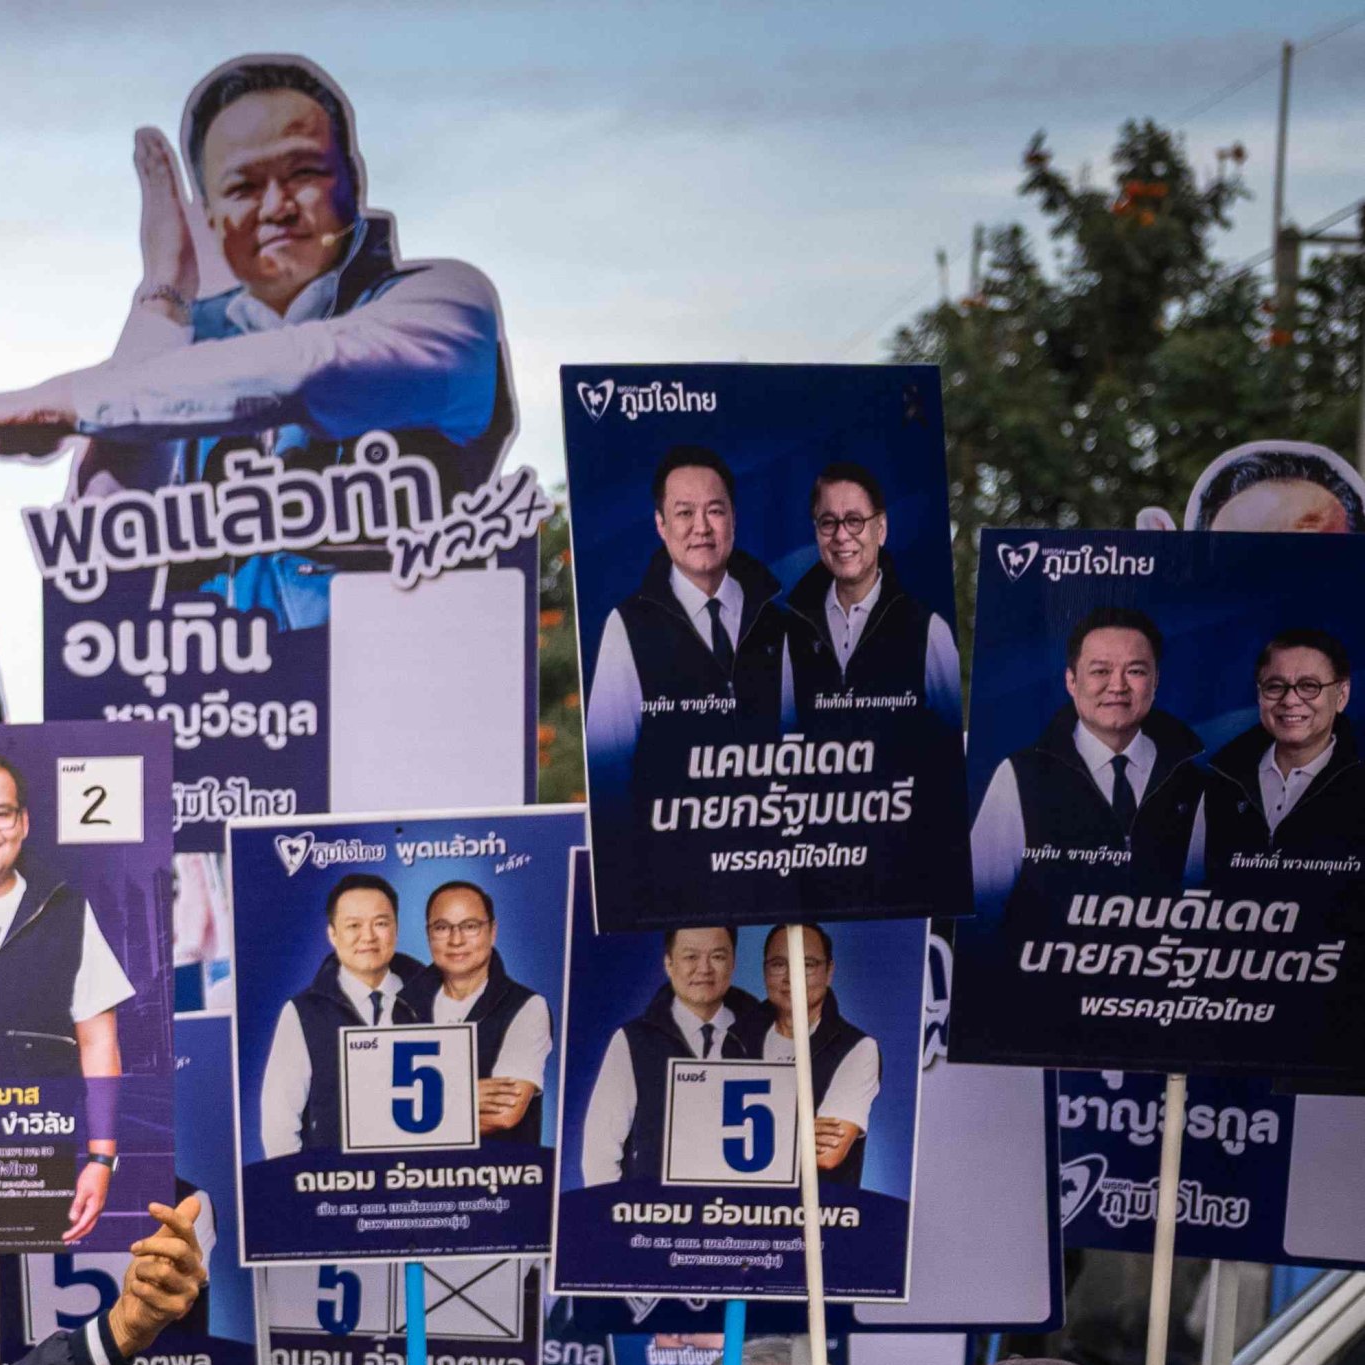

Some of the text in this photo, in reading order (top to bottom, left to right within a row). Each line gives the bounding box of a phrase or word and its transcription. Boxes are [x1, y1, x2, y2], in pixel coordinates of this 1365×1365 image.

[619, 382, 717, 421] ภูมิใจไทย
[27, 442, 437, 592] พูดแล้วทำ
[1042, 545, 1156, 581] ภูมิใจไทย
[62, 602, 273, 697] อนุทิน
[640, 694, 676, 715] อนุทิน
[687, 733, 874, 780] แคนดิเดต
[79, 785, 112, 826] 2
[649, 776, 915, 838] นายกรัฐมนตรี
[396, 831, 507, 868] พูดแล้วทำ
[709, 844, 868, 878] พรรคภูมิใจไทย
[1067, 888, 1301, 934] แคนดิเดต
[1018, 934, 1347, 988] นายกรัฐมนตรี
[1079, 993, 1276, 1027] พรรคภูมิใจไทย
[349, 1038, 379, 1050] เบอร์
[390, 1041, 445, 1135] 5
[676, 1071, 708, 1083] เบอร์
[1, 1110, 76, 1136] ขำวิลัย
[721, 1078, 776, 1174] 5
[295, 1162, 543, 1196] ถนอม อ่อนเกตุพล
[611, 1202, 692, 1224] ถนอม
[53, 1253, 121, 1330] 5
[317, 1262, 361, 1337] 5
